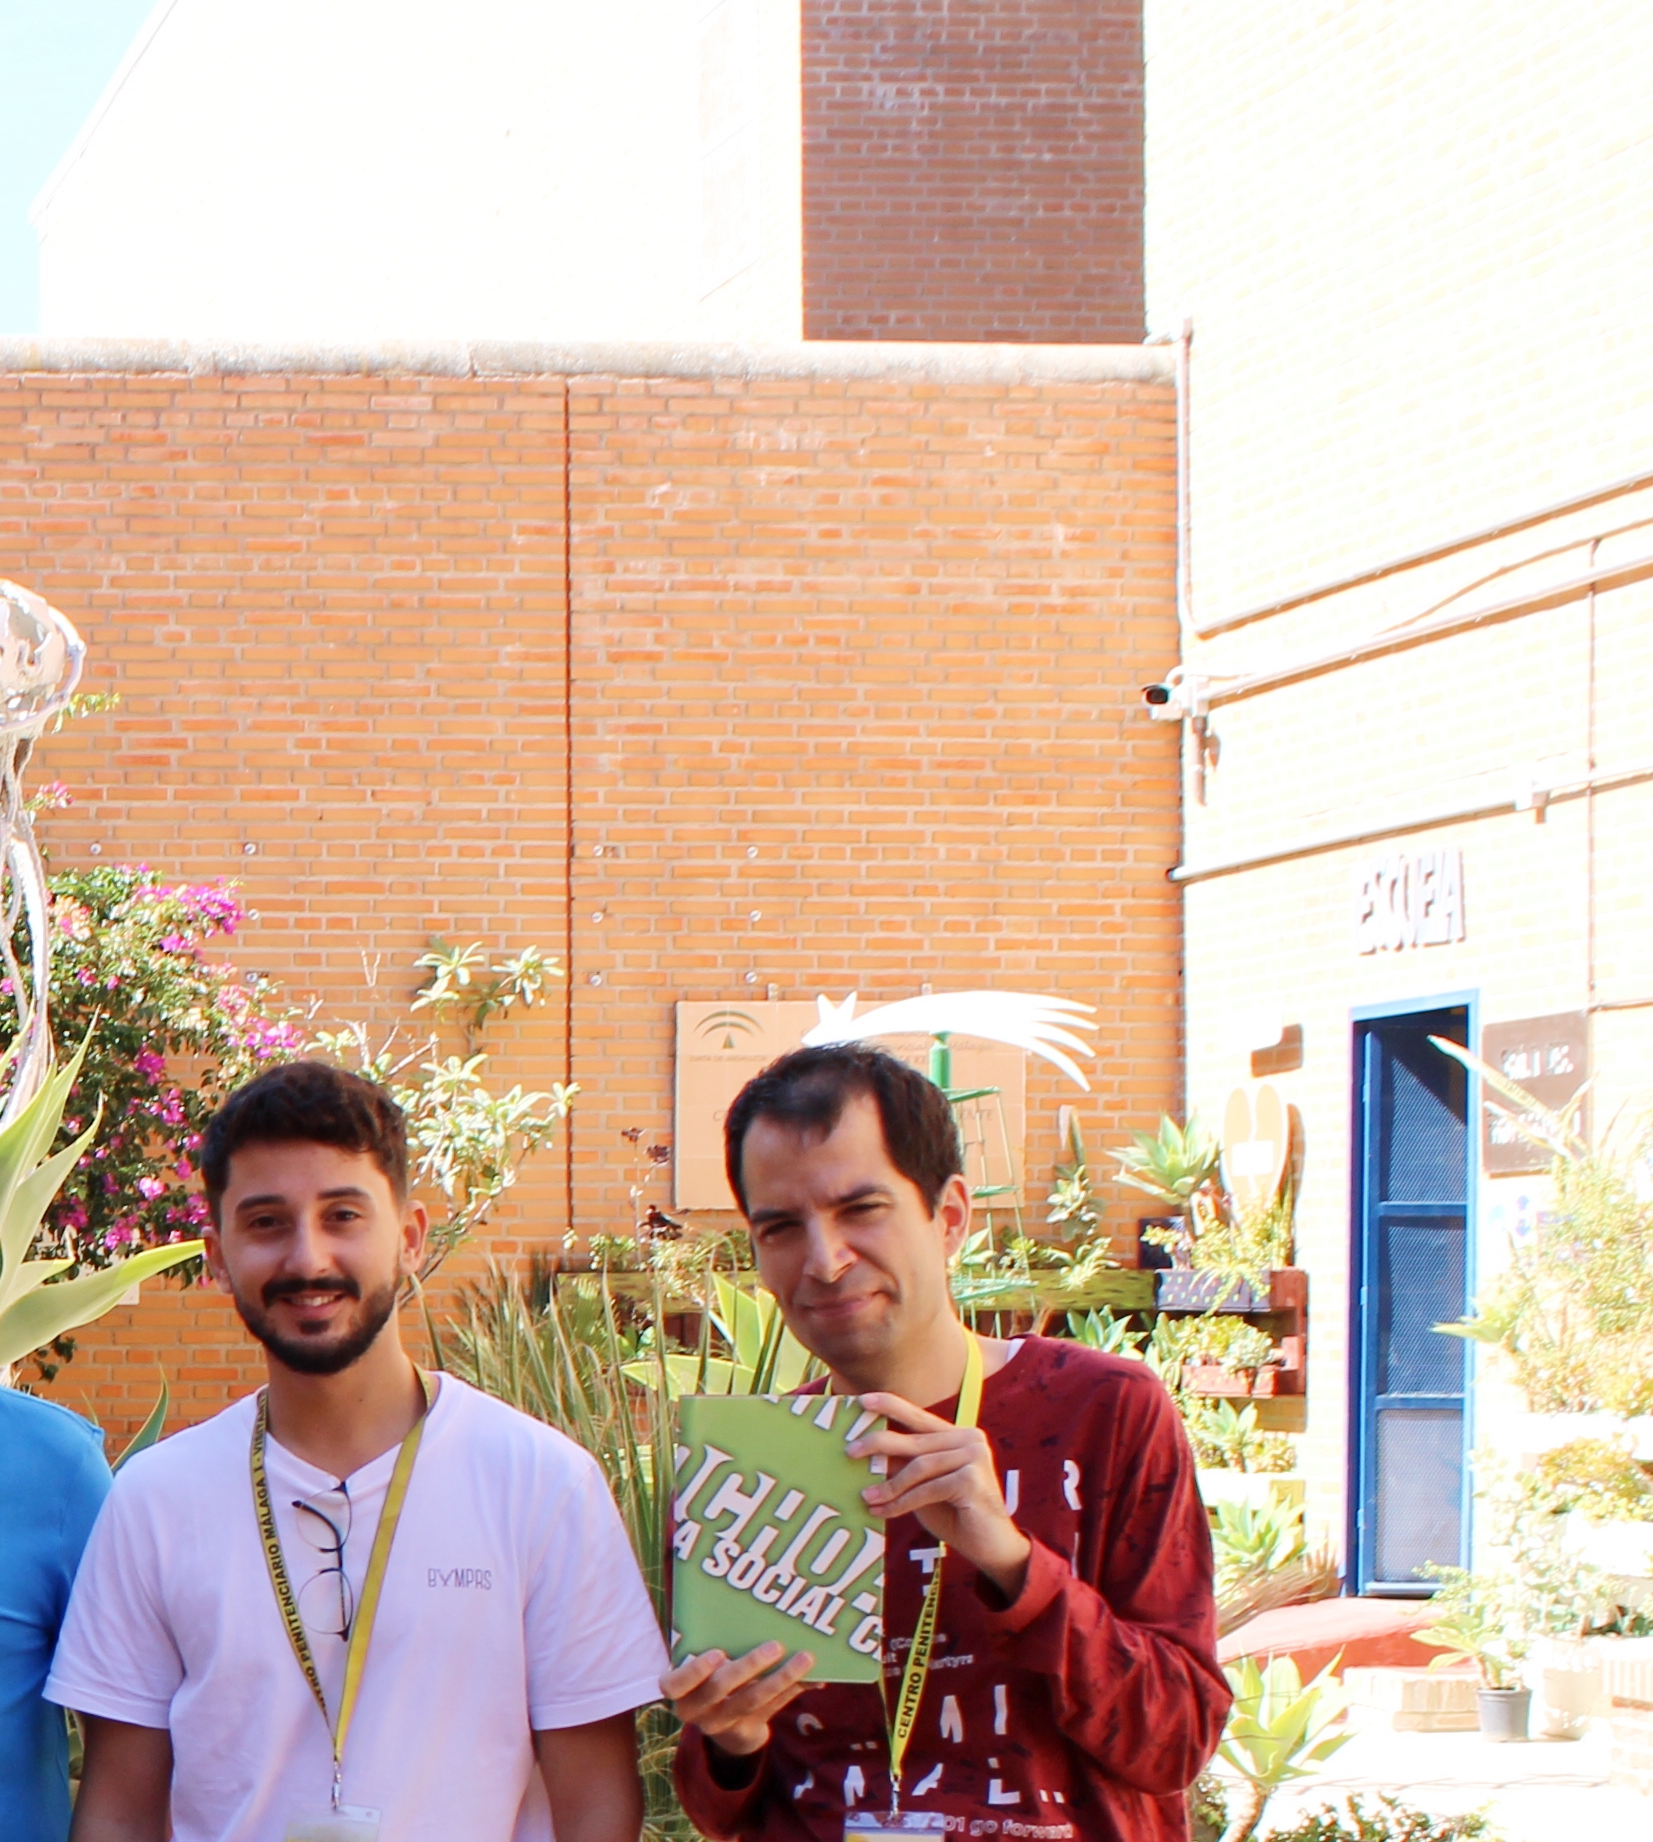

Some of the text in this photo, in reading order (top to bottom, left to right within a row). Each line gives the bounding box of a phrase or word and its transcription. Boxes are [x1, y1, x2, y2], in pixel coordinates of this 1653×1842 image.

[268, 1543, 311, 1664] PENITENCIARIO
[702, 1538, 845, 1636] SOCIAL
[897, 1671, 922, 1739] CENTRO
[970, 1820, 997, 1837] go
